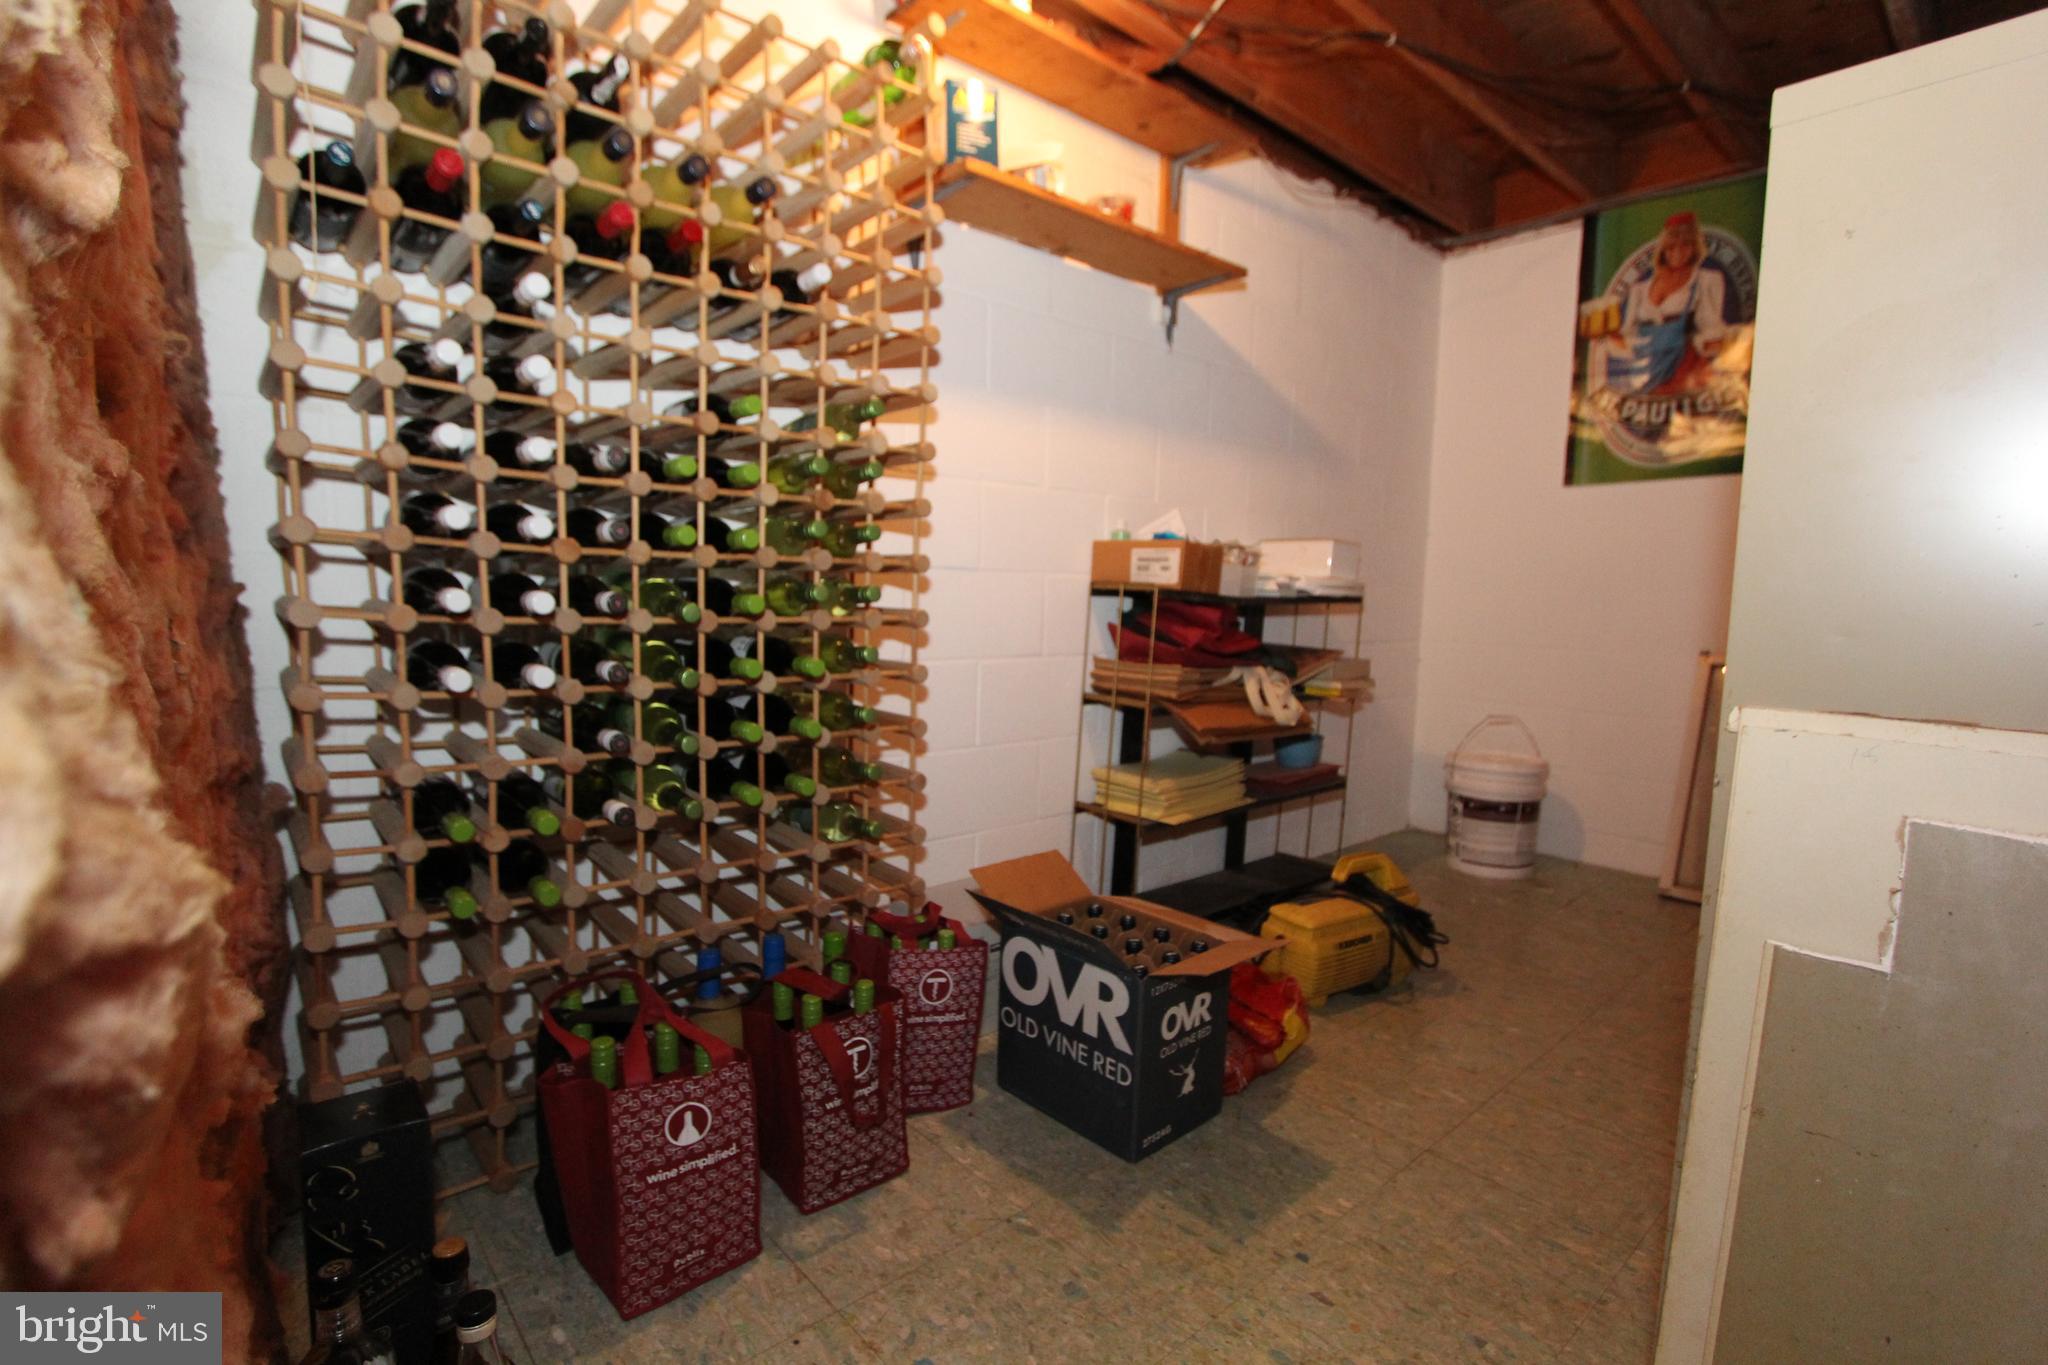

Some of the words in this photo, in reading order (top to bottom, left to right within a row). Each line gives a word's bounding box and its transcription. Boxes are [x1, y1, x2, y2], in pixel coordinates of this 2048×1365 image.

[1002, 936, 1133, 1055] OVR
[1160, 991, 1213, 1041] OVR
[1000, 1005, 1039, 1039] OLD
[1042, 1025, 1088, 1066] VINE
[1092, 1051, 1132, 1087] RED
[1160, 1042, 1178, 1059] OLD
[1197, 1025, 1213, 1040] RED
[646, 1168, 679, 1184] wine
